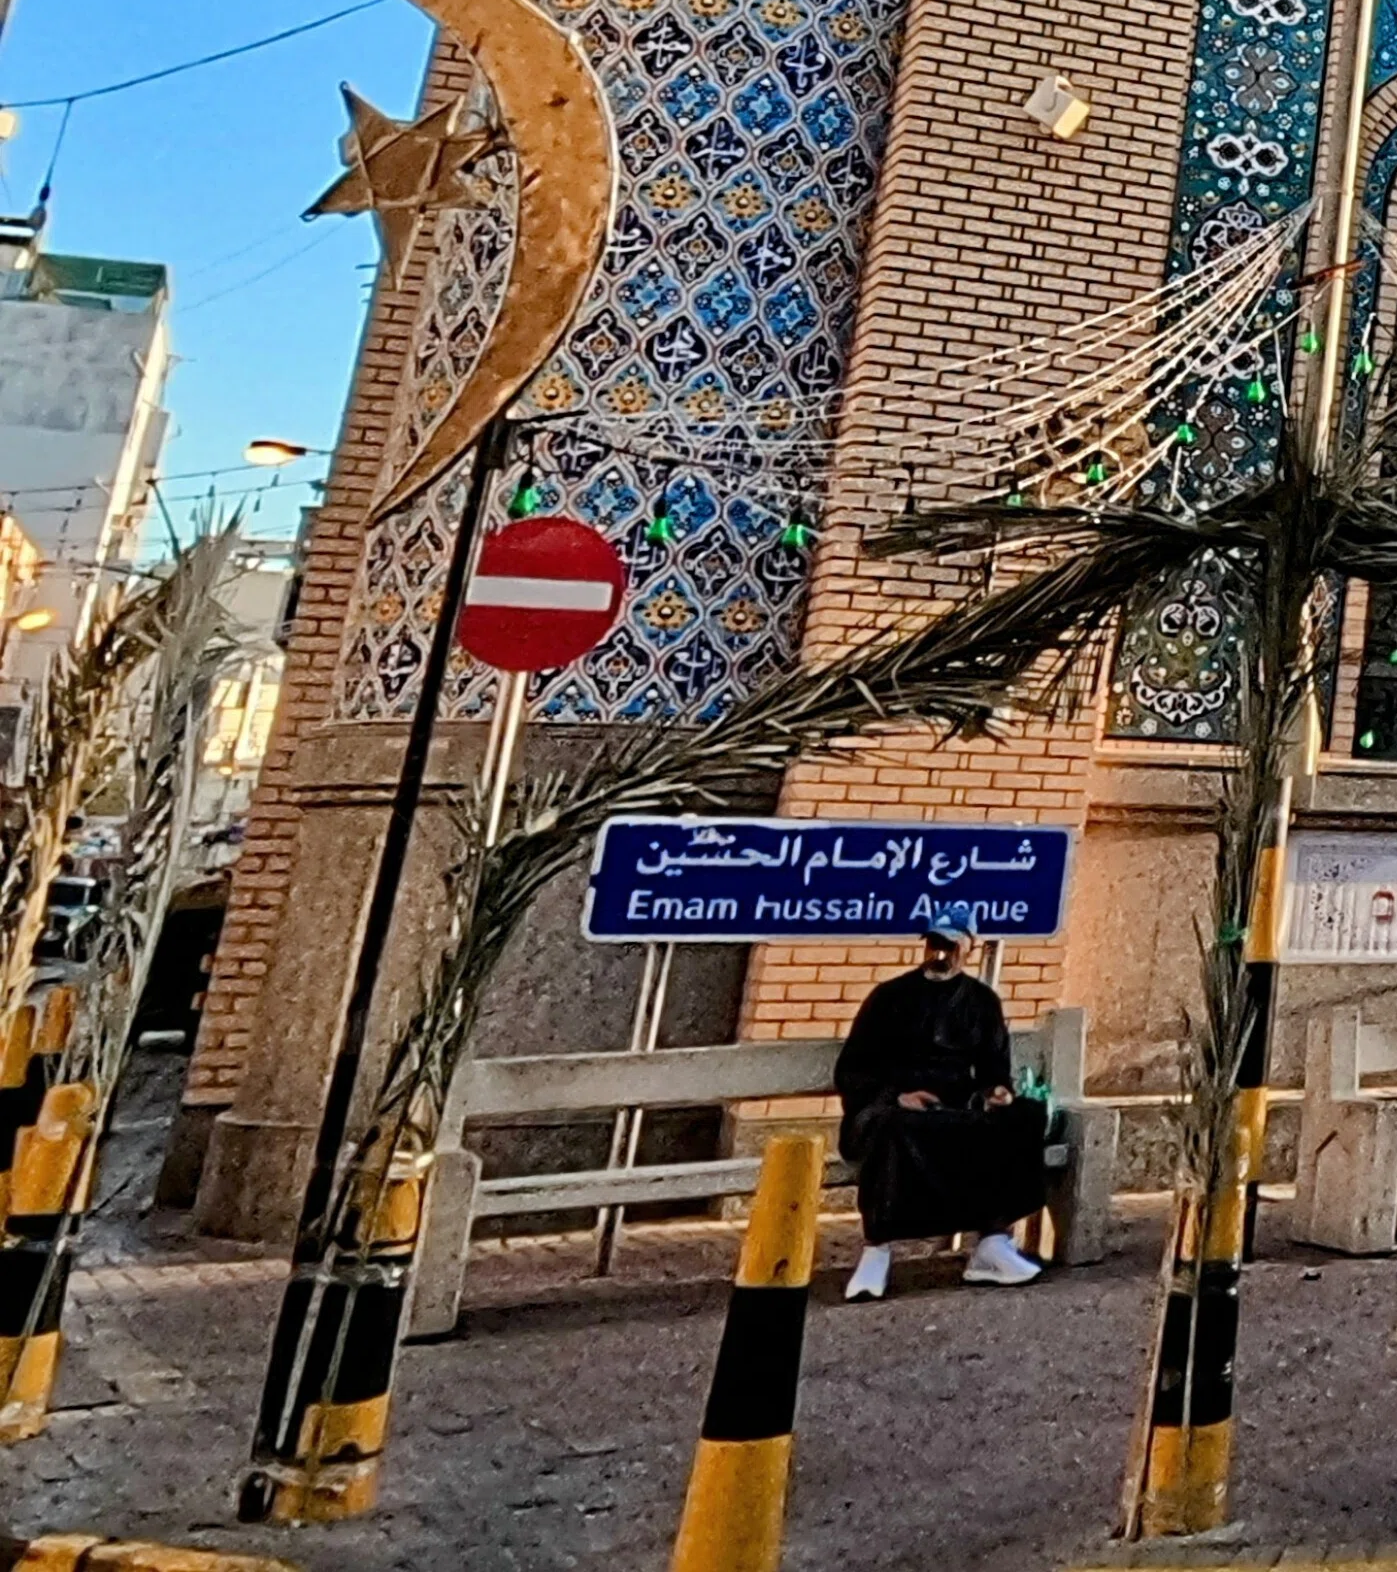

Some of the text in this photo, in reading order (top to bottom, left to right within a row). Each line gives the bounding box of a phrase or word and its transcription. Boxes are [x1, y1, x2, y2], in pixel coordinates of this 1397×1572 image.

[635, 833, 803, 877] الحسين
[927, 838, 1037, 887] شارع
[626, 888, 739, 921] Emam
